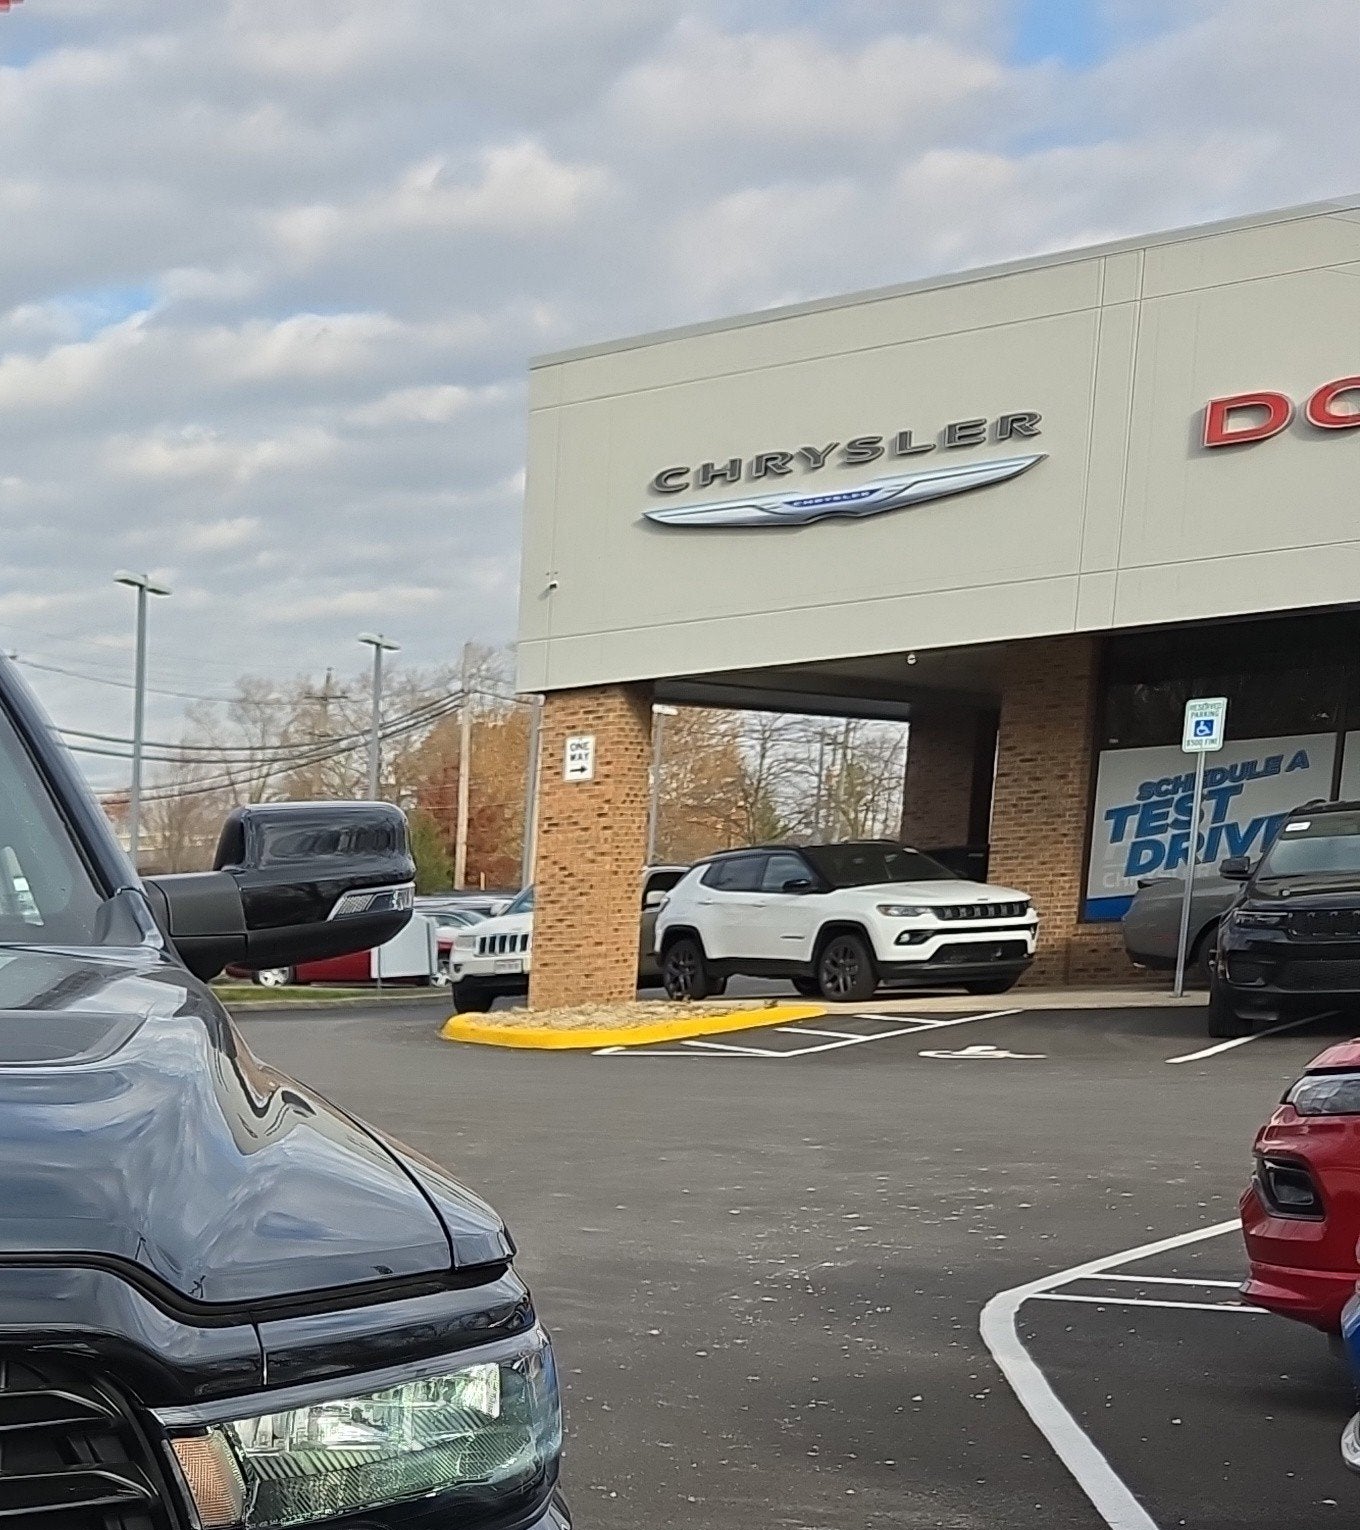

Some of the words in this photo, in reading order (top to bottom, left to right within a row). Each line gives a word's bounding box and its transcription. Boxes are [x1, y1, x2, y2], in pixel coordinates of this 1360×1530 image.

[651, 410, 1043, 493] CHRYSLER
[569, 741, 590, 751] ONE
[569, 752, 590, 761] WAY
[1284, 749, 1311, 773] A
[1103, 782, 1245, 845] TEST
